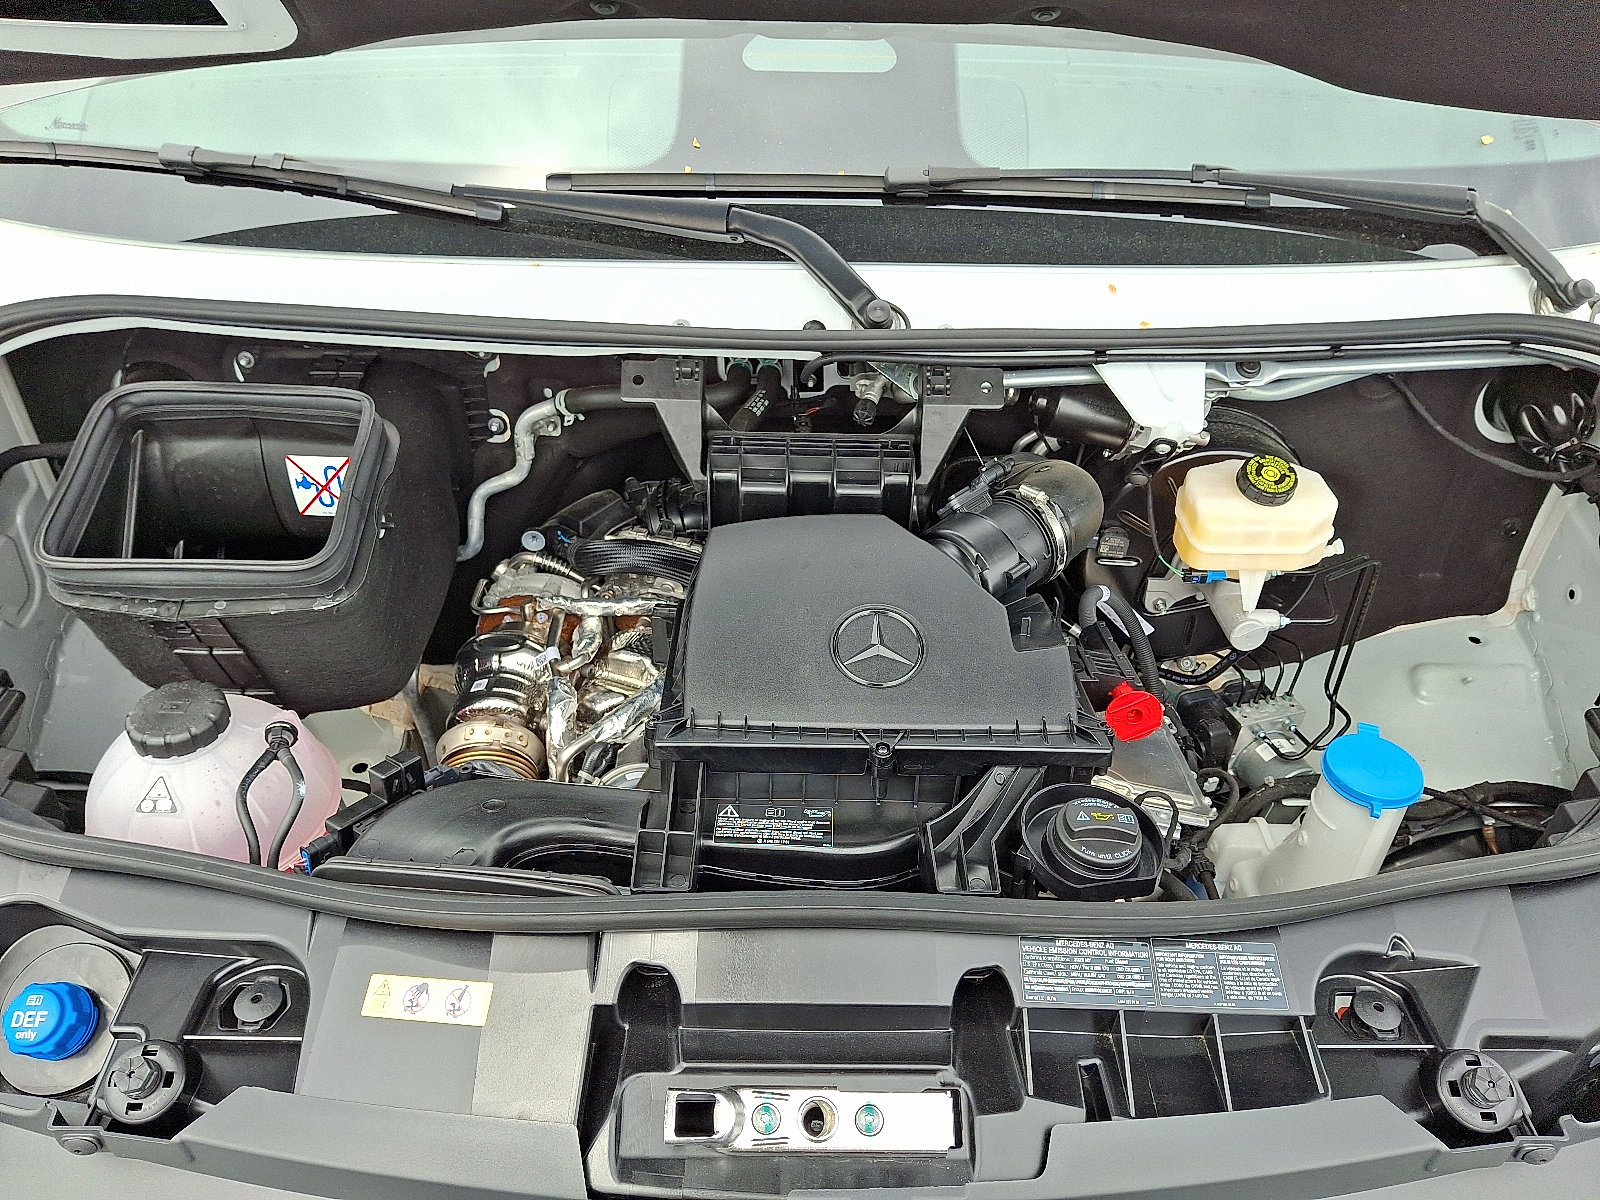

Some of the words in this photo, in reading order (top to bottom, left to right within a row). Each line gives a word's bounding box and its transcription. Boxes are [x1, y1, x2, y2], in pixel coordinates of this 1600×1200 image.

[1081, 846, 1096, 857] Turn
[1114, 849, 1132, 859] CLICK
[1055, 939, 1105, 949] MERCEDES-BENZ
[1106, 941, 1115, 950] AG
[1185, 942, 1233, 951] MERCEDES-BENZ
[1234, 944, 1243, 952] AG
[1022, 945, 1048, 953] VEHICLE
[1048, 947, 1077, 955] EMISSION
[1078, 948, 1107, 957] CONTROL
[1108, 950, 1149, 959] INFORMATION
[10, 1010, 49, 1028] DEF
[15, 1029, 38, 1042] only
